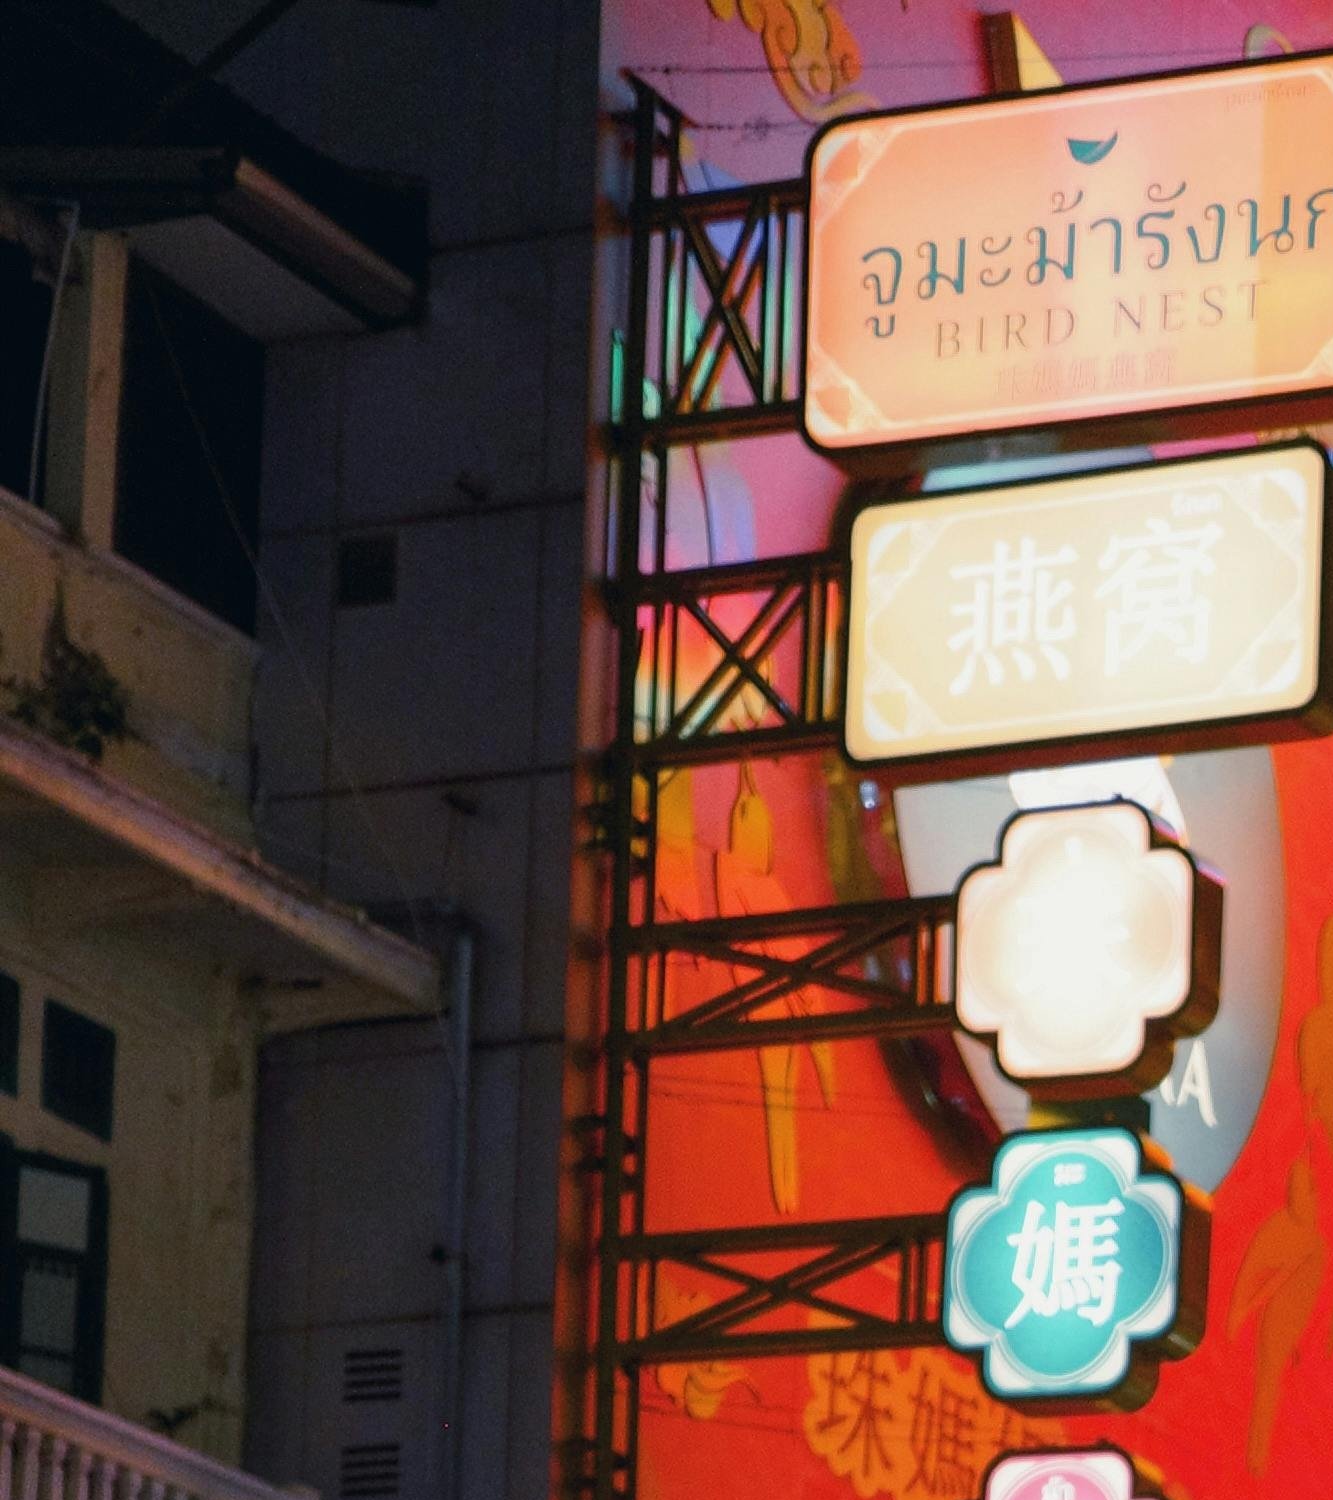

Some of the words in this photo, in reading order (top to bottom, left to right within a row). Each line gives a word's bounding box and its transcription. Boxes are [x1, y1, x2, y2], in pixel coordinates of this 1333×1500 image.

[935, 306, 1076, 358] BIRD
[1112, 278, 1268, 336] NEST
[1004, 1197, 1125, 1328] 媽
